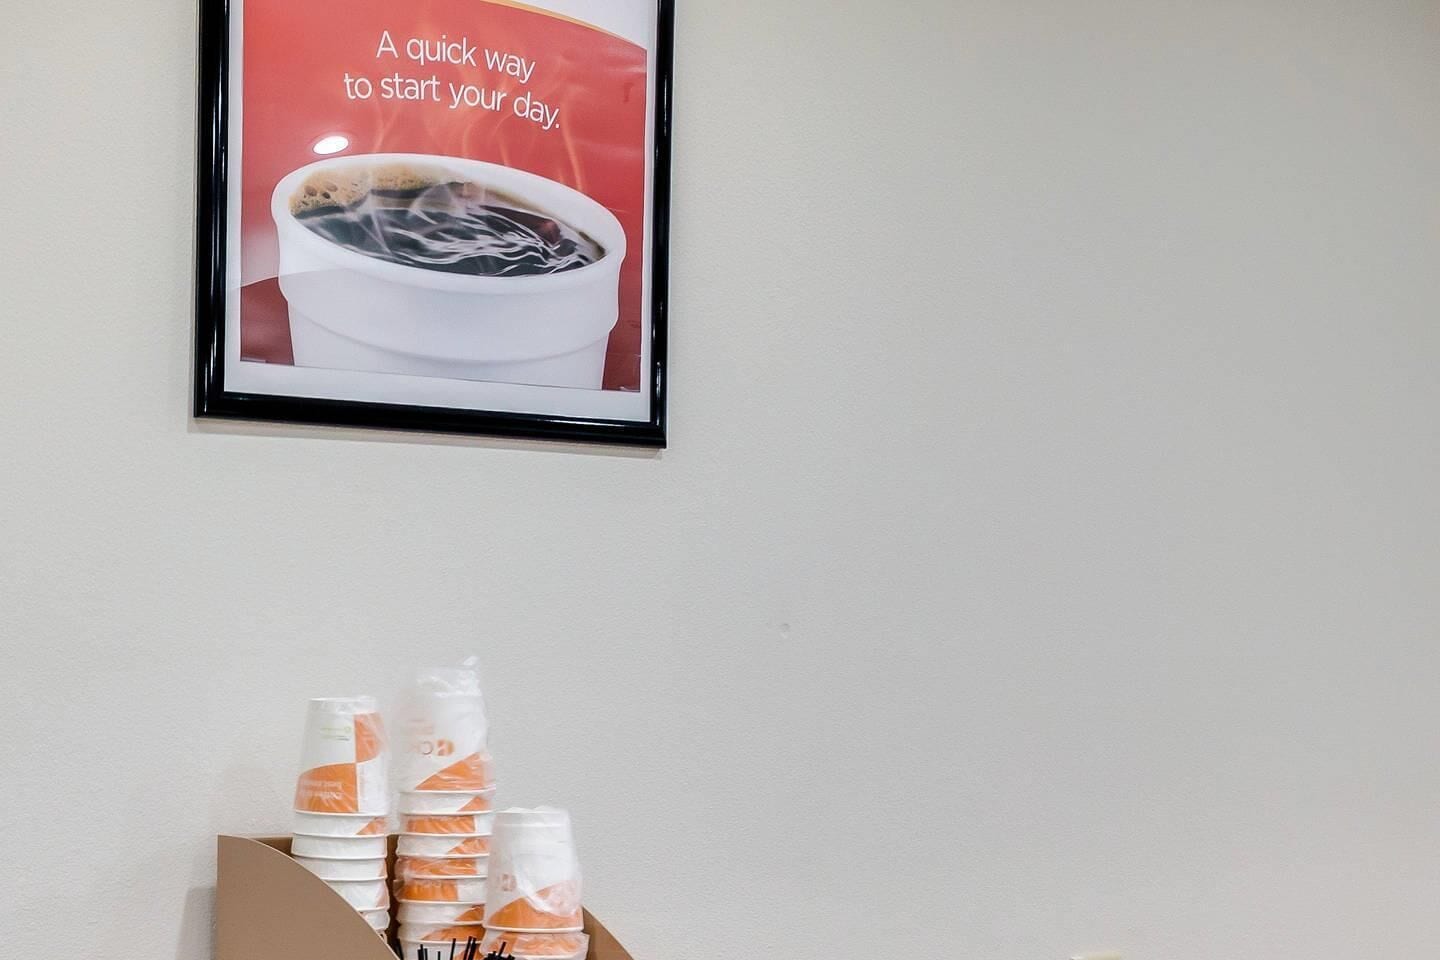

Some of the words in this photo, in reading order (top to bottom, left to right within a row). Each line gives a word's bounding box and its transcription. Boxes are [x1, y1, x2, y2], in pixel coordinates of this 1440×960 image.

[376, 30, 399, 58] A
[406, 34, 477, 67] quick
[484, 49, 536, 84] way
[343, 72, 373, 100] to
[380, 72, 441, 102] start
[448, 82, 507, 112] your
[513, 91, 561, 130] day.
